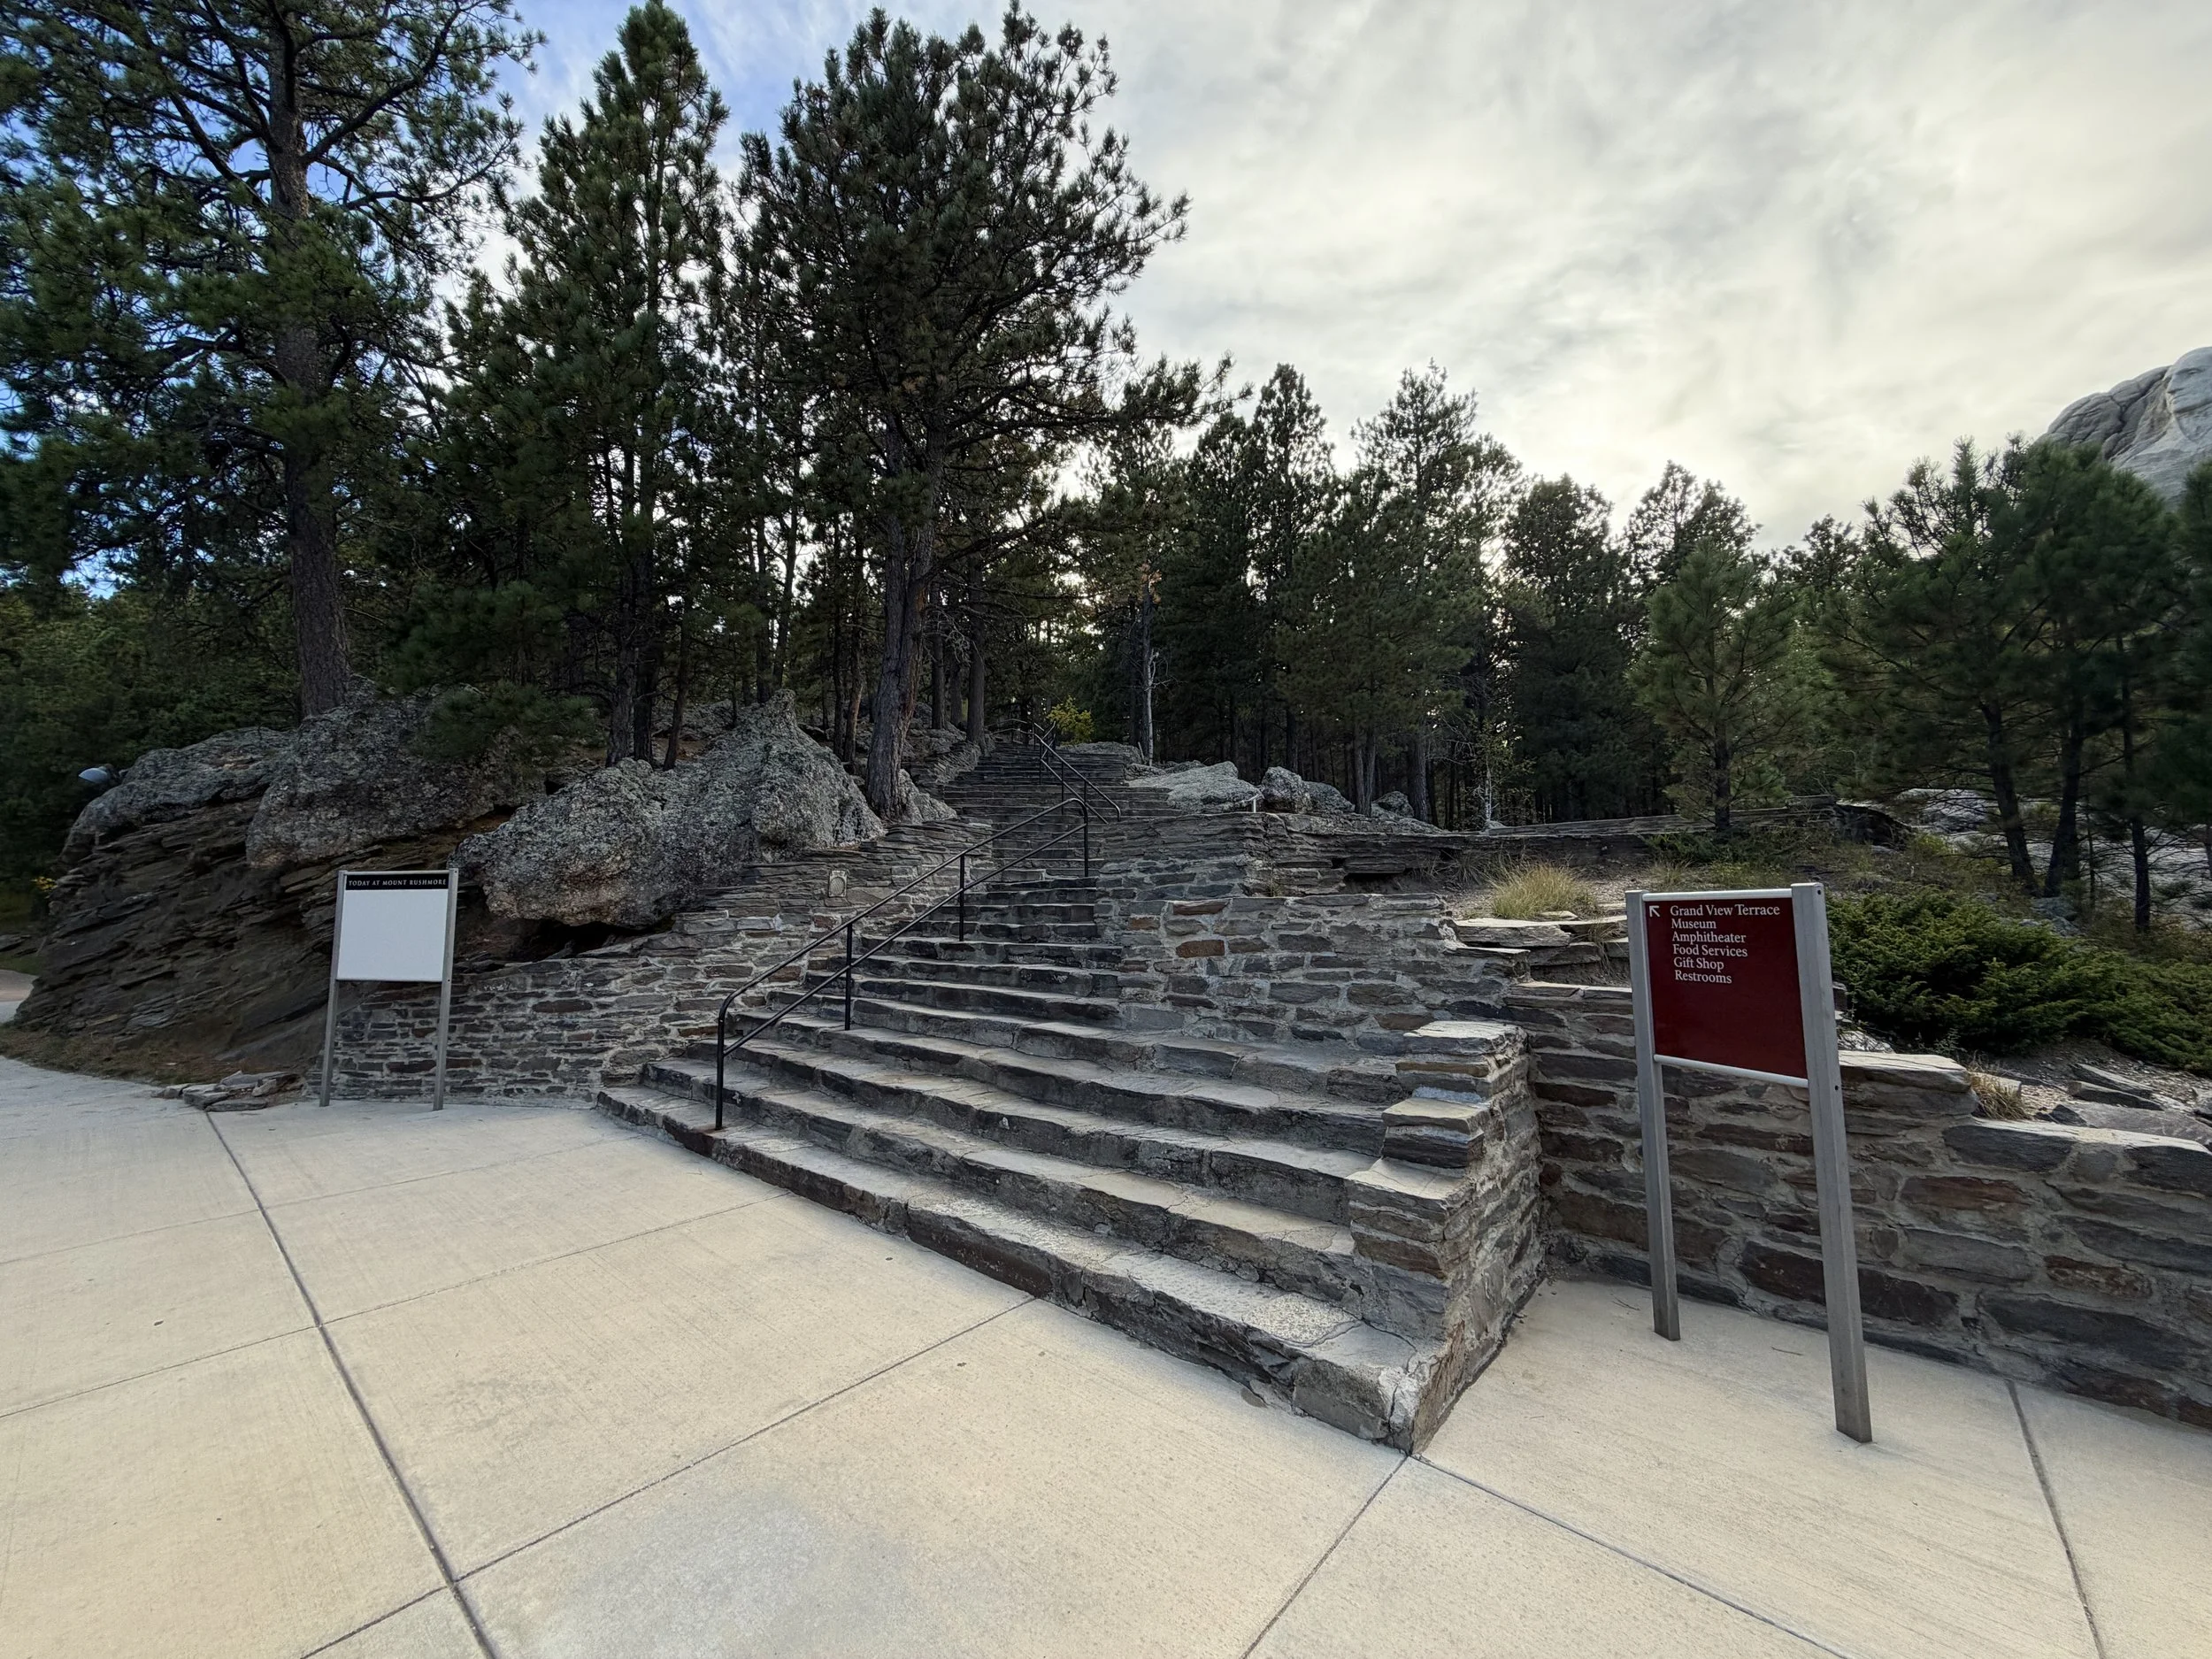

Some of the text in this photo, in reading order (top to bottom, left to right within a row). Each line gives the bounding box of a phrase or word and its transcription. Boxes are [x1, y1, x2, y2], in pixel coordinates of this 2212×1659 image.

[1670, 903, 1780, 916] Grand View Terrace
[1671, 918, 1717, 929] Museum
[1672, 931, 1747, 945] Amphitheater
[1673, 944, 1748, 957] Food Services
[1673, 956, 1724, 972] Gift Shop
[1675, 970, 1732, 984] Restrooms
